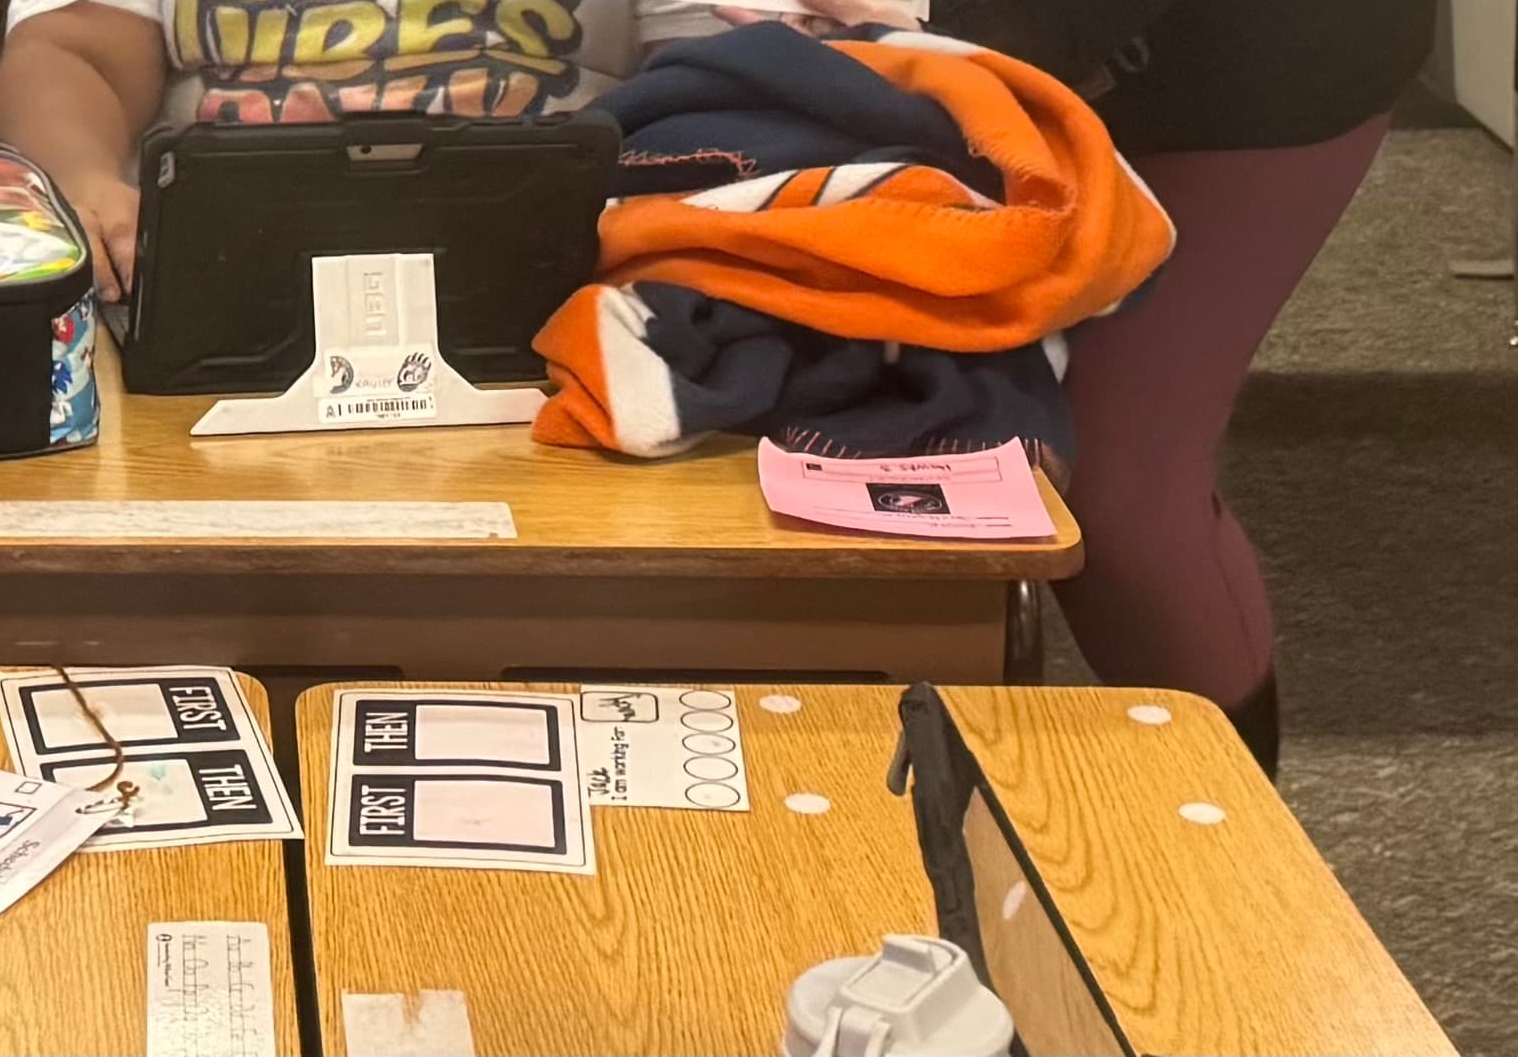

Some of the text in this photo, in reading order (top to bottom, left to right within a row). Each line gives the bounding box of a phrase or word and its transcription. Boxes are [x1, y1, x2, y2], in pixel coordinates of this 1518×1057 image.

[169, 686, 227, 731] FIRST
[364, 712, 408, 752] THEN
[611, 743, 629, 776] working
[198, 764, 257, 811] THEN
[615, 779, 627, 793] am
[360, 785, 406, 835] FIRST
